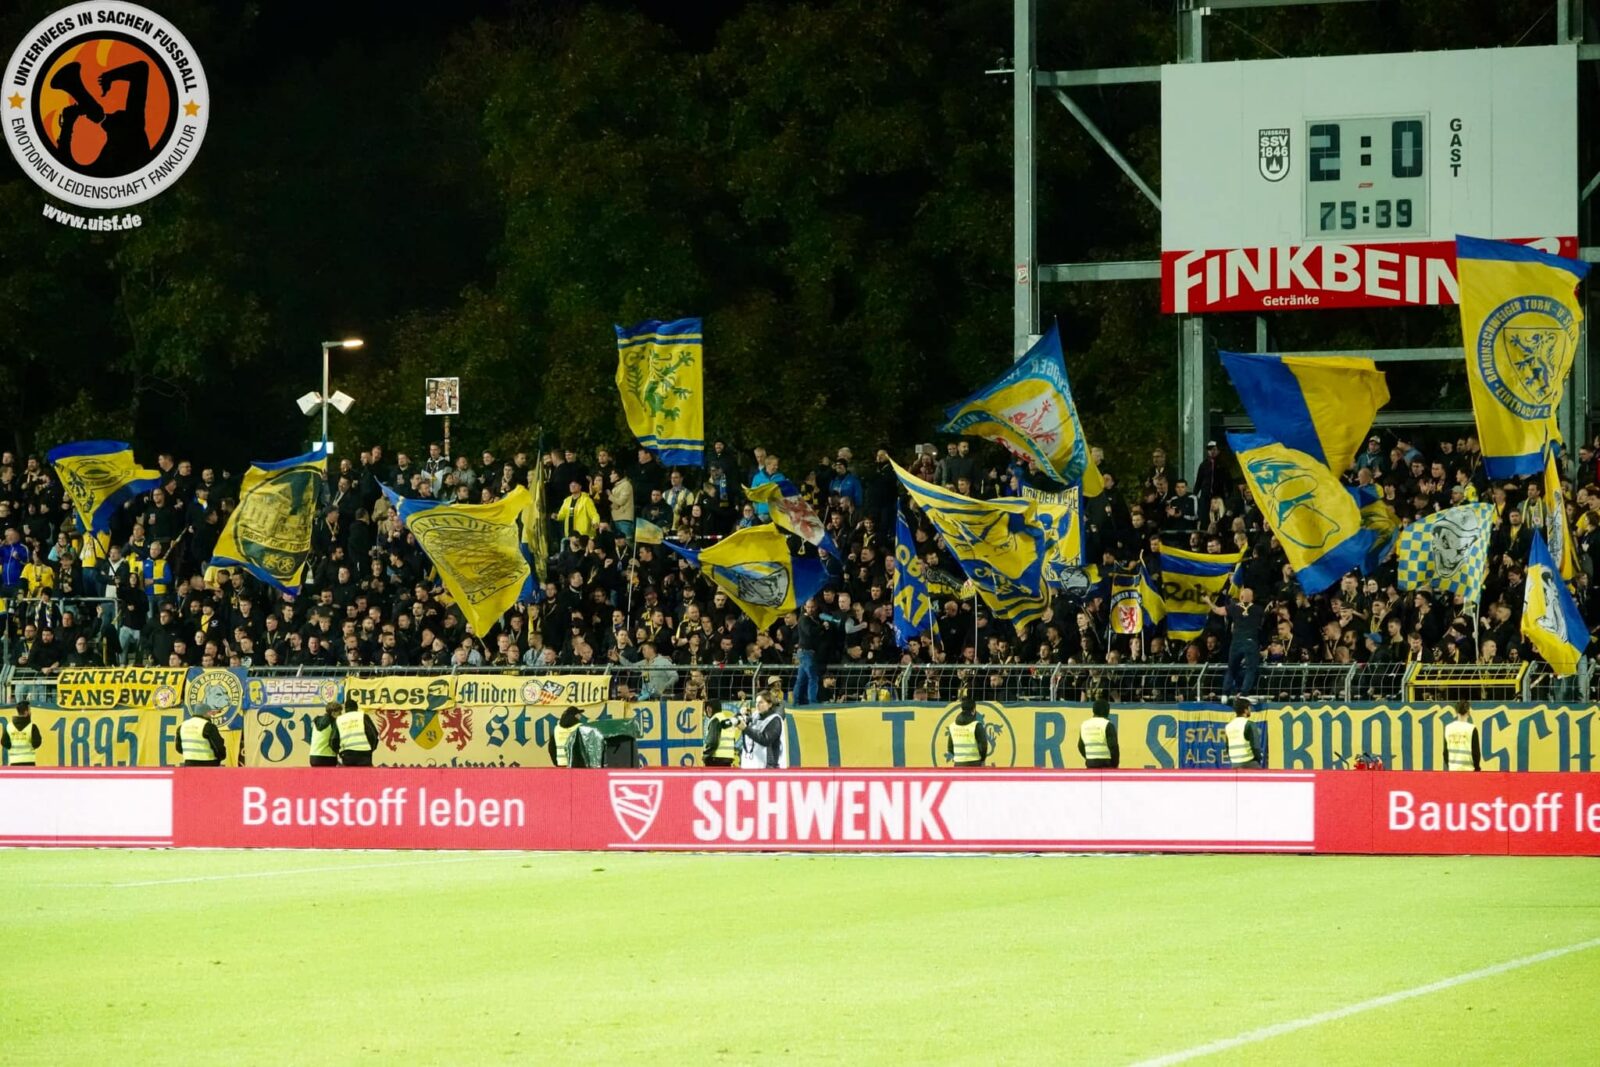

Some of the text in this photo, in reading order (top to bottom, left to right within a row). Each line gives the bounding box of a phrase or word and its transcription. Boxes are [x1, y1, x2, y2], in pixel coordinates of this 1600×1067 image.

[1260, 136, 1289, 147] SSV
[1260, 146, 1289, 158] 1846
[1320, 199, 1413, 231] 75:39
[1174, 237, 1560, 313] FINKBEIN
[1262, 293, 1320, 307] Getränke
[60, 669, 184, 686] EINTRACHT
[60, 689, 151, 706] FANS BW
[346, 687, 425, 705] CHAOS
[459, 681, 608, 704] Müden Aller
[50, 716, 138, 767] 1895
[1185, 723, 1227, 743] STÄR
[1279, 709, 1599, 771] BRAUSCH
[241, 786, 526, 828] Baustoff leben
[692, 779, 946, 842] SCHWENK
[1388, 790, 1600, 833] Baustoff le
